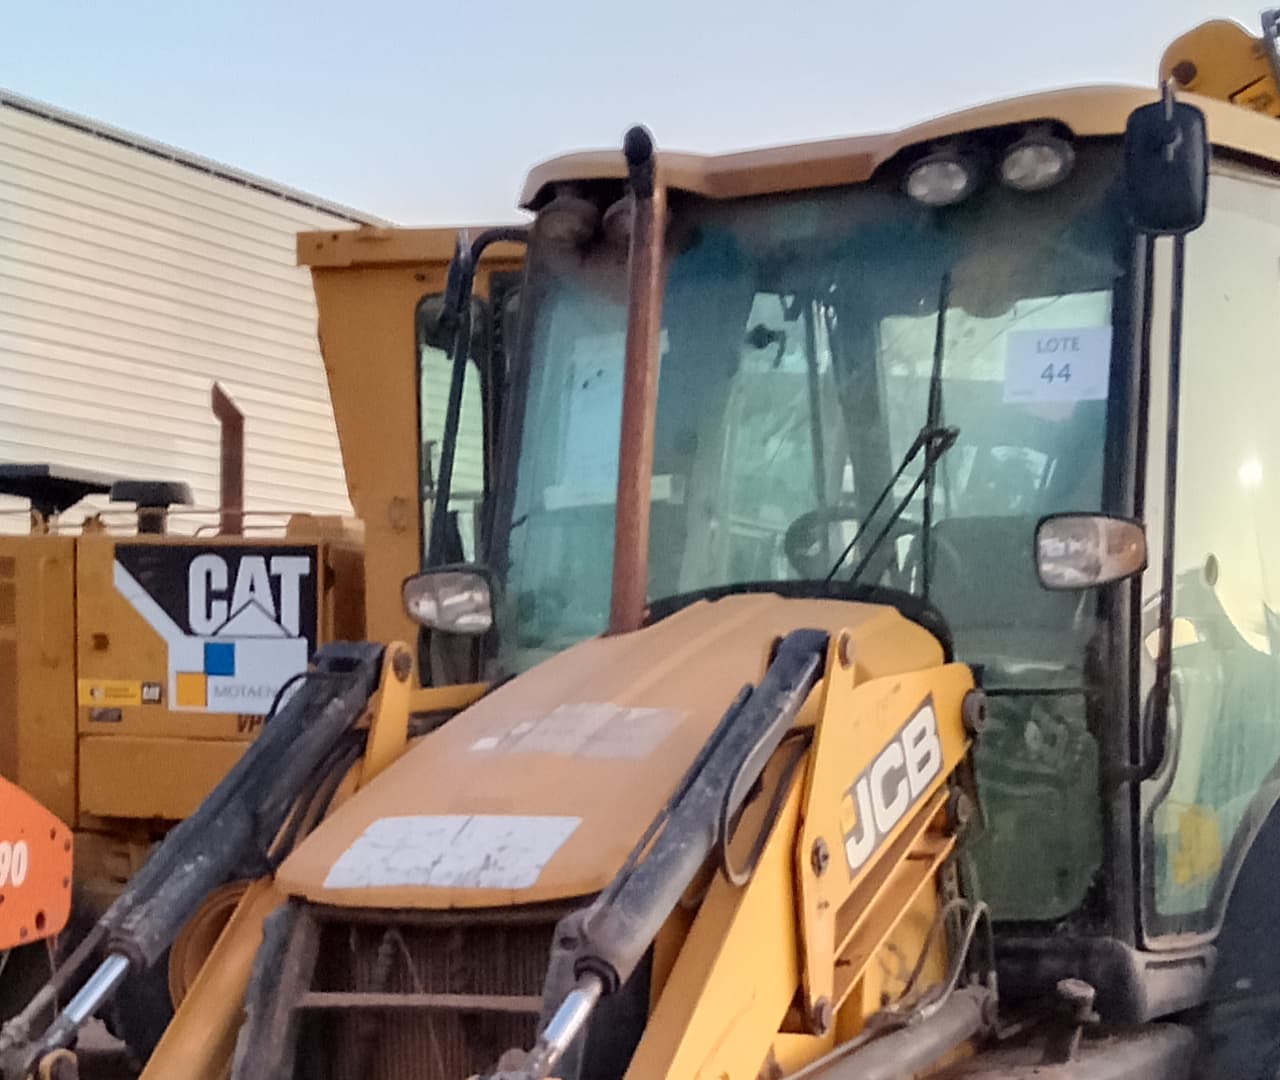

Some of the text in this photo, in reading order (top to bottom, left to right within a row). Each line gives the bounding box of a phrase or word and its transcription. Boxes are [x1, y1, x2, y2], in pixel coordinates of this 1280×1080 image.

[1036, 336, 1081, 354] LOTE
[1040, 363, 1072, 384] 44
[188, 553, 311, 636] CAT
[845, 705, 942, 869] JCB
